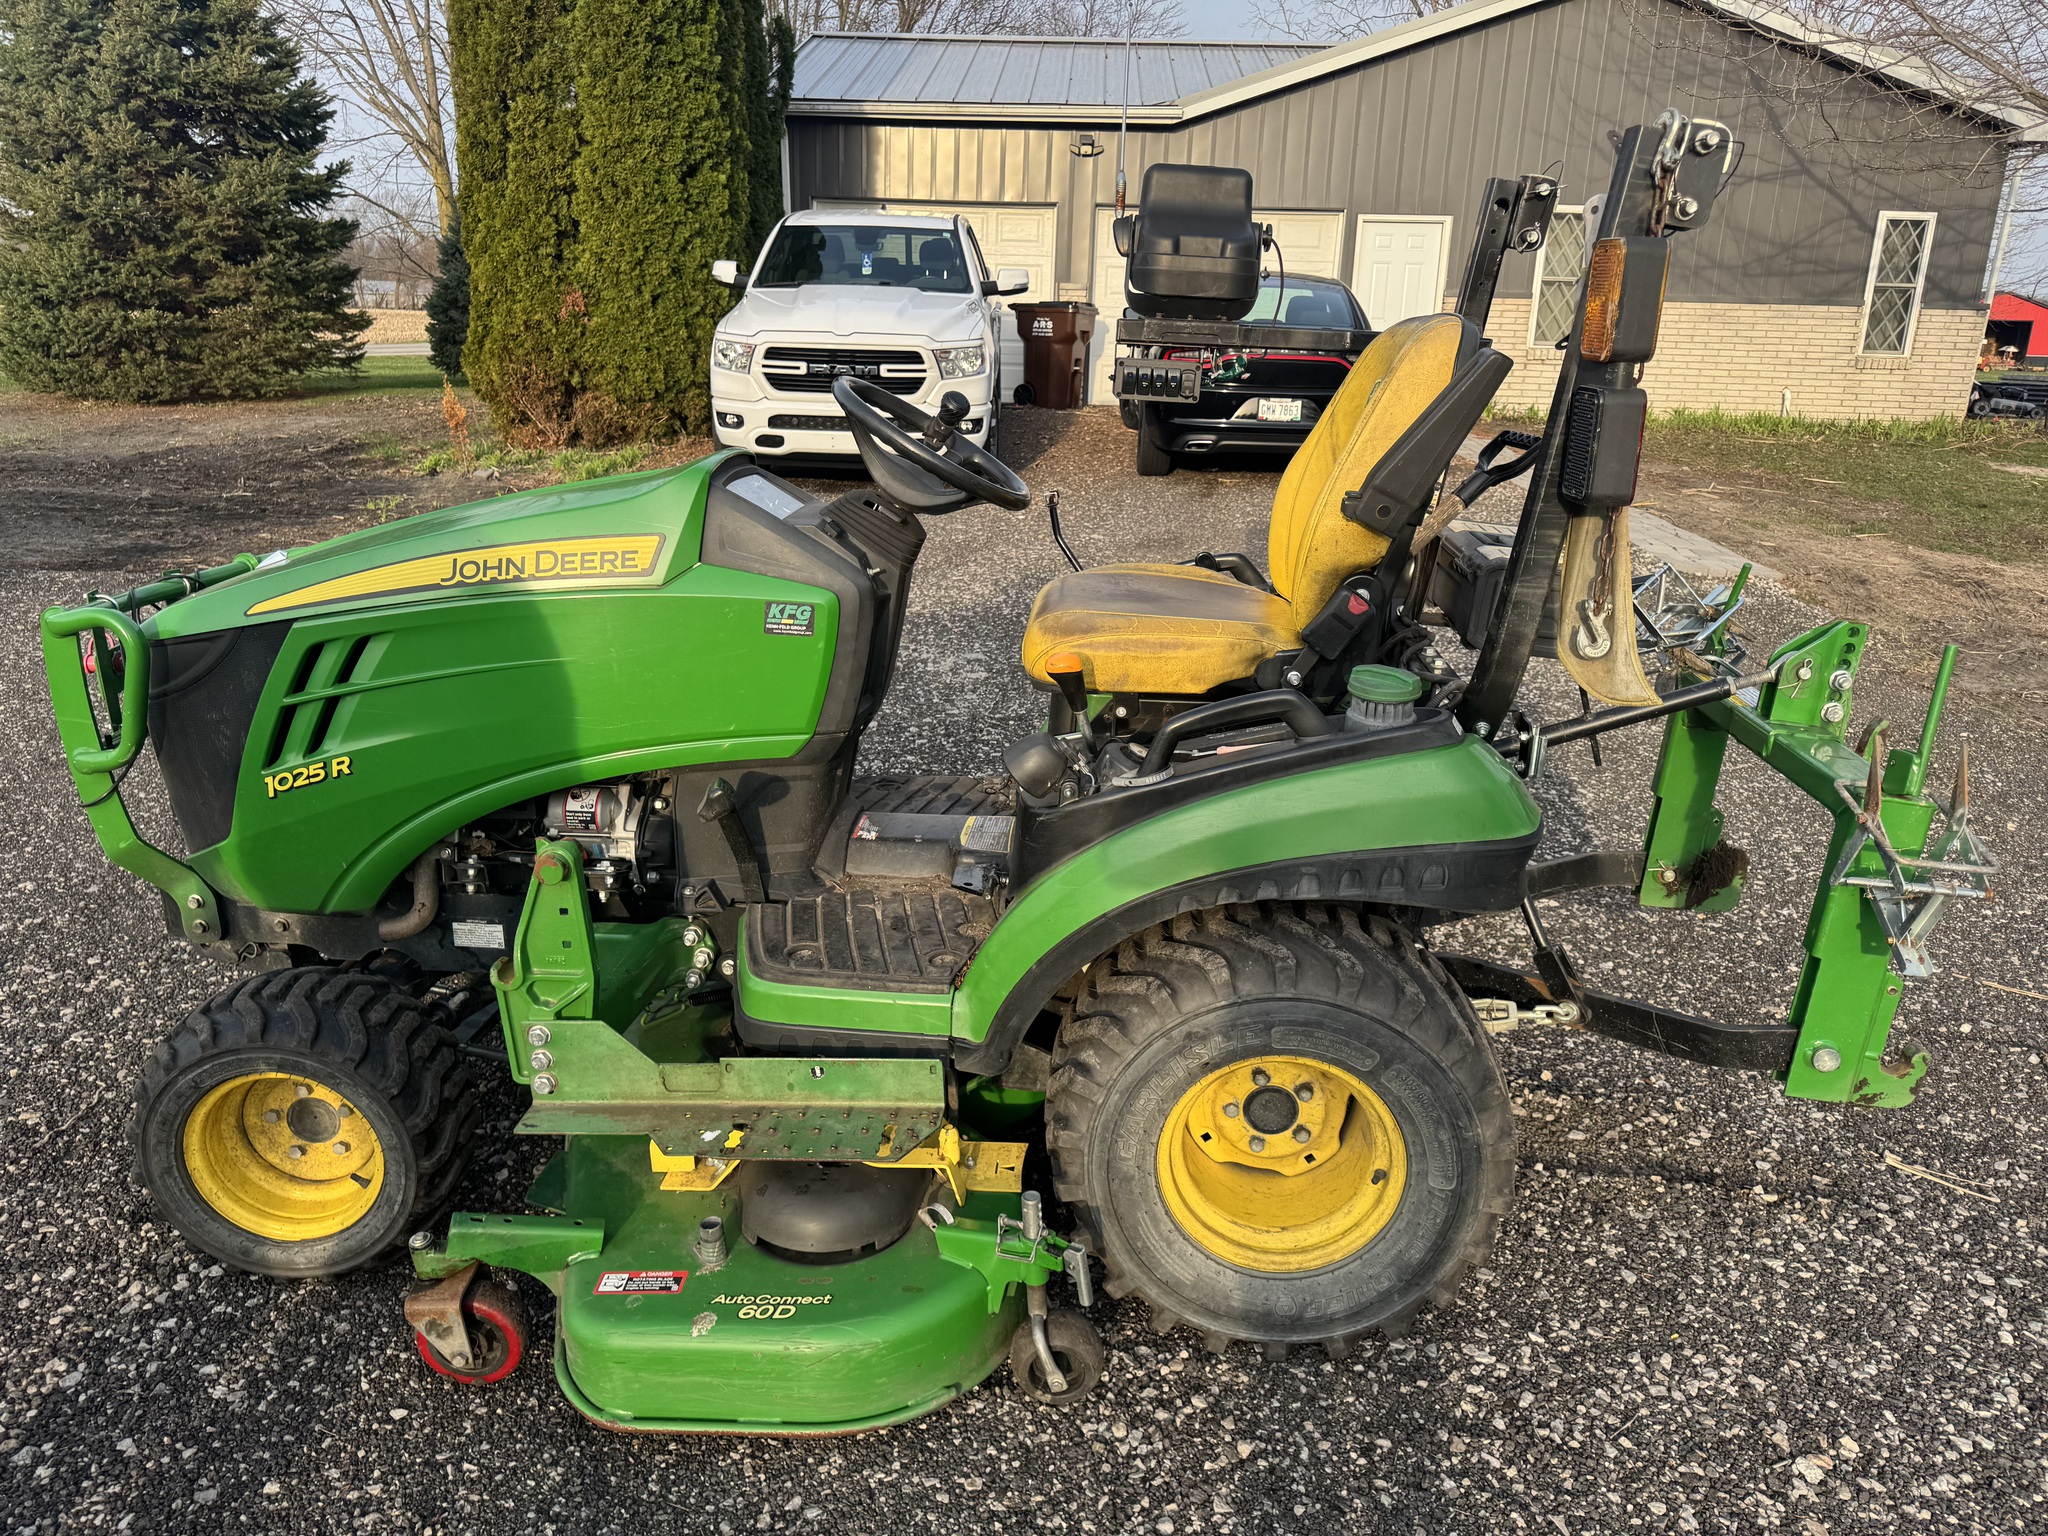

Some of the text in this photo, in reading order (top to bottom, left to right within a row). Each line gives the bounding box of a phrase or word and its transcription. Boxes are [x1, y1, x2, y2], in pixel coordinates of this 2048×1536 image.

[809, 363, 878, 375] RAM
[1279, 404, 1299, 416] 7863
[440, 550, 639, 583] JOHN DEERE
[768, 603, 812, 620] KFG
[264, 756, 352, 798] 1025 R
[1115, 1024, 1264, 1166] CARLISLE
[1304, 1191, 1452, 1319] TRAC CHIEF
[711, 1294, 833, 1304] AutoConnect
[737, 1304, 797, 1320] 60D
